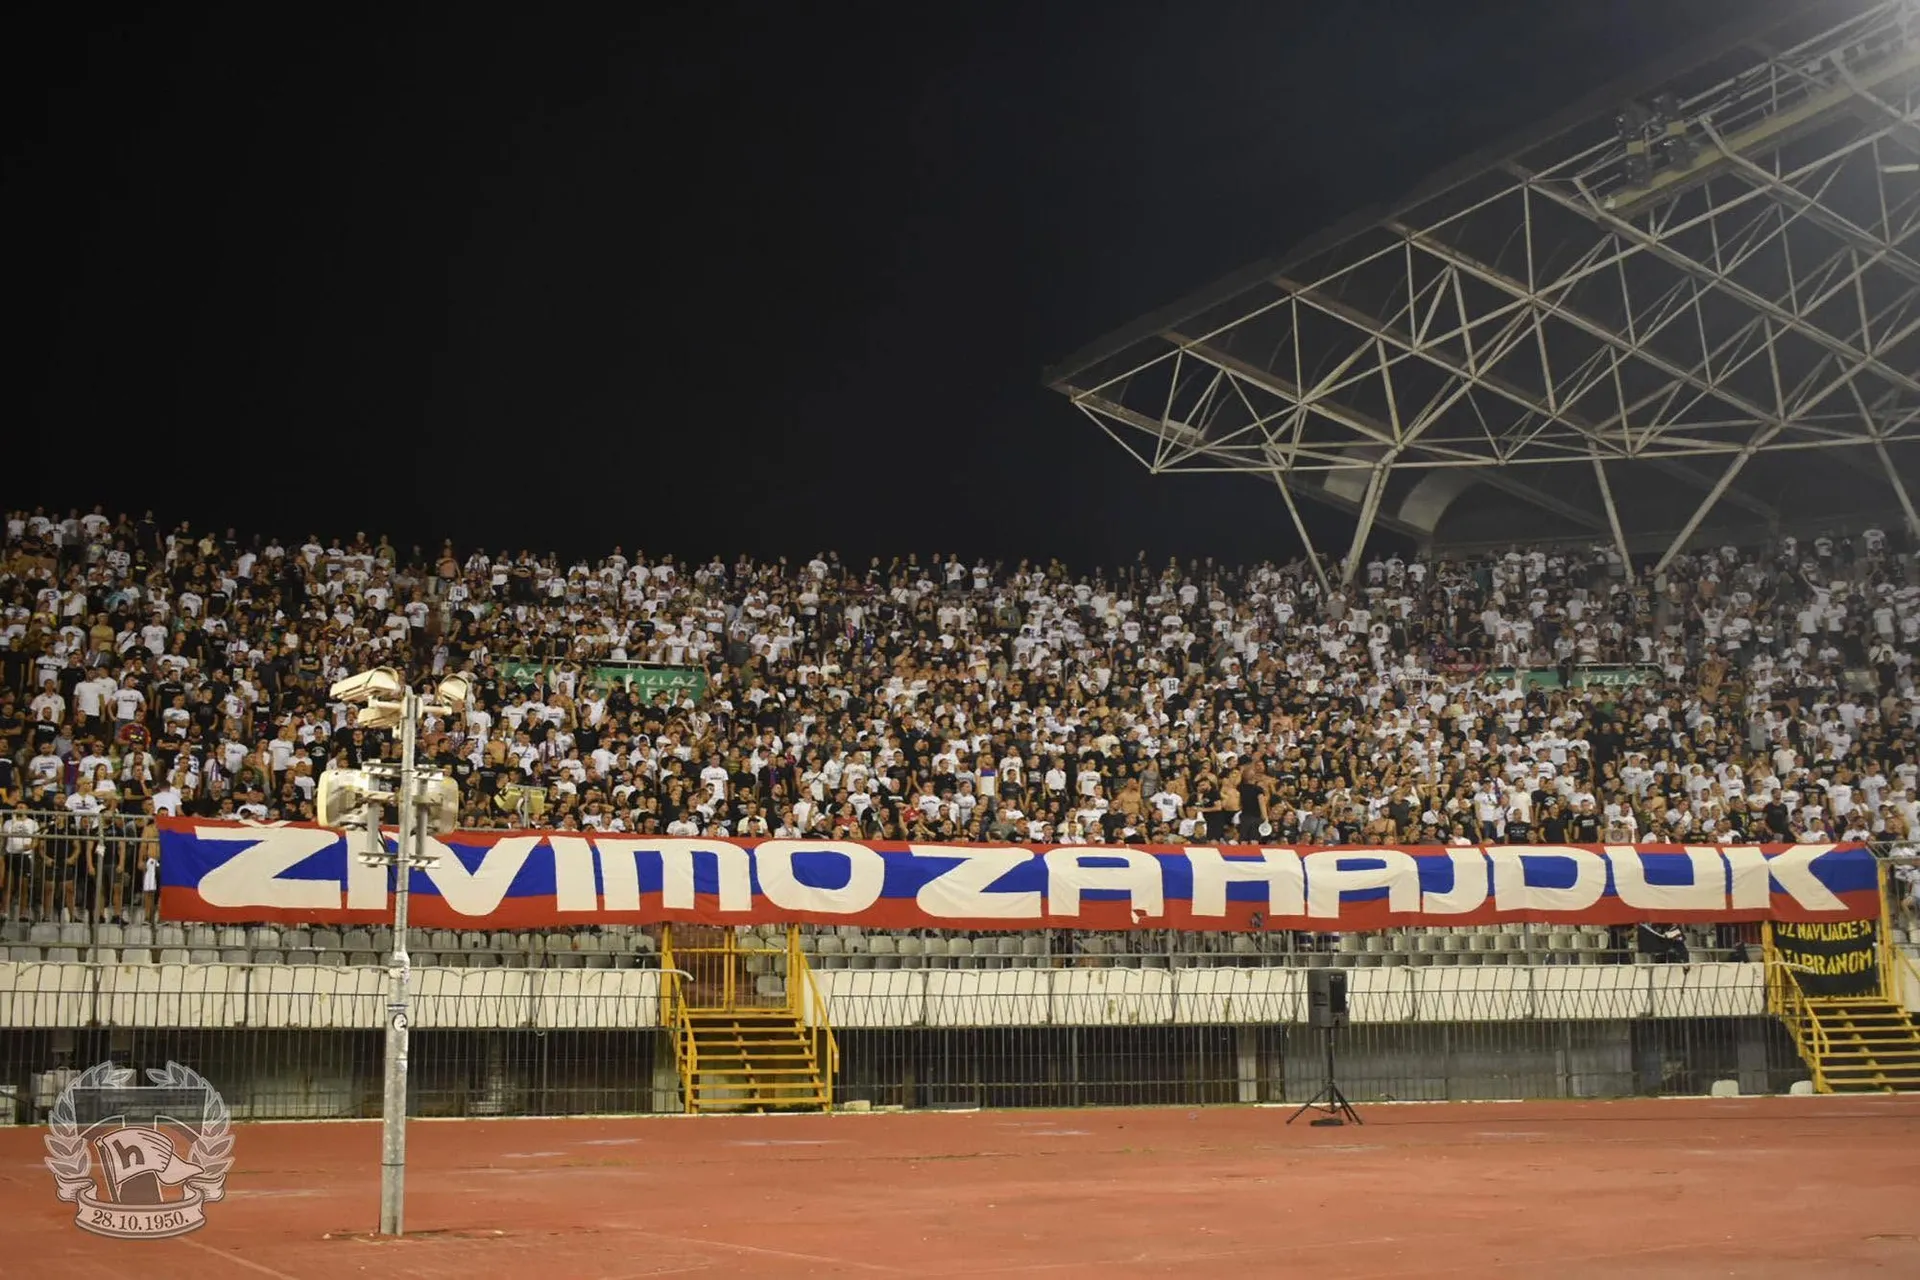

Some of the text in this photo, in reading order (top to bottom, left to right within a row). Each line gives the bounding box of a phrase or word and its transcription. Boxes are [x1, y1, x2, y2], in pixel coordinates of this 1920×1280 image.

[1168, 680, 1176, 690] H
[194, 819, 1848, 920] ŽIVIMO ZA HAJDUK
